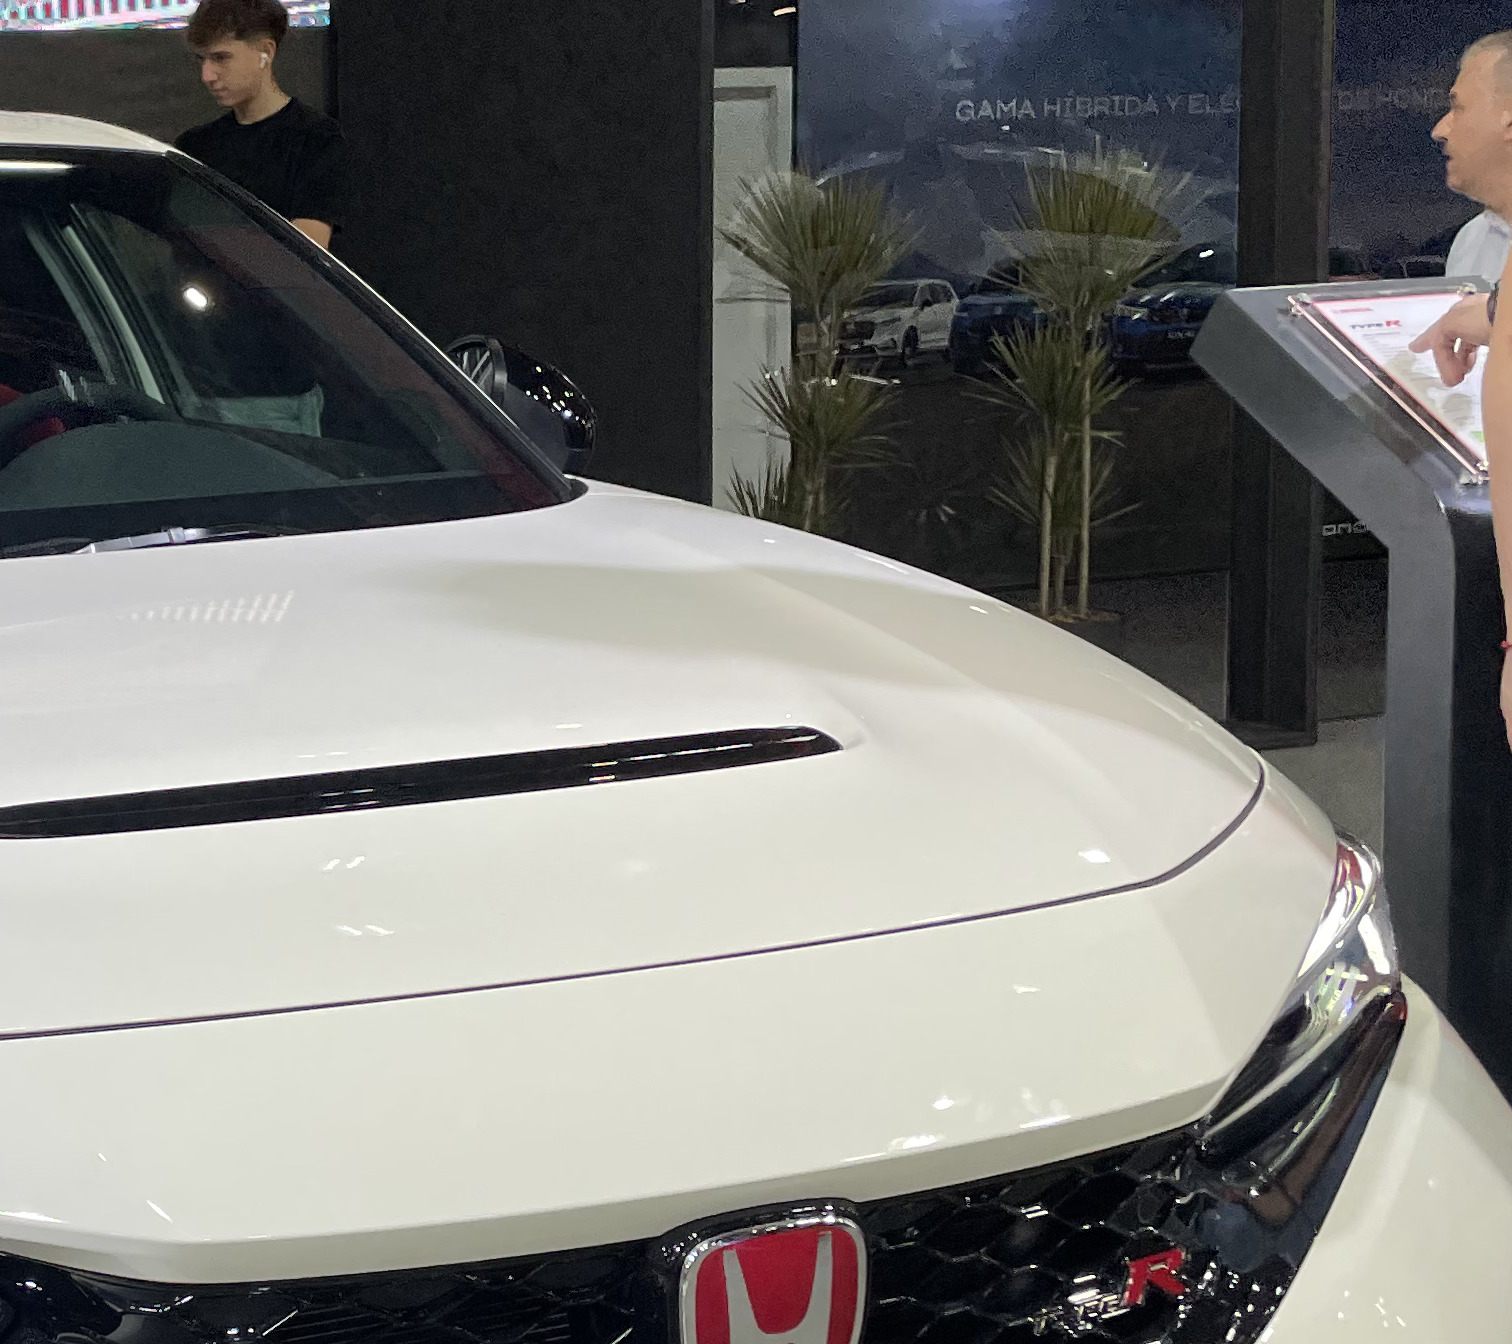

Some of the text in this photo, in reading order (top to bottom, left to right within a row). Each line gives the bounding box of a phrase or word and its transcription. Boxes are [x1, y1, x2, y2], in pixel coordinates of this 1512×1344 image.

[955, 98, 1036, 122] GAMA
[1165, 95, 1183, 116] Y
[1120, 1248, 1188, 1307] R
